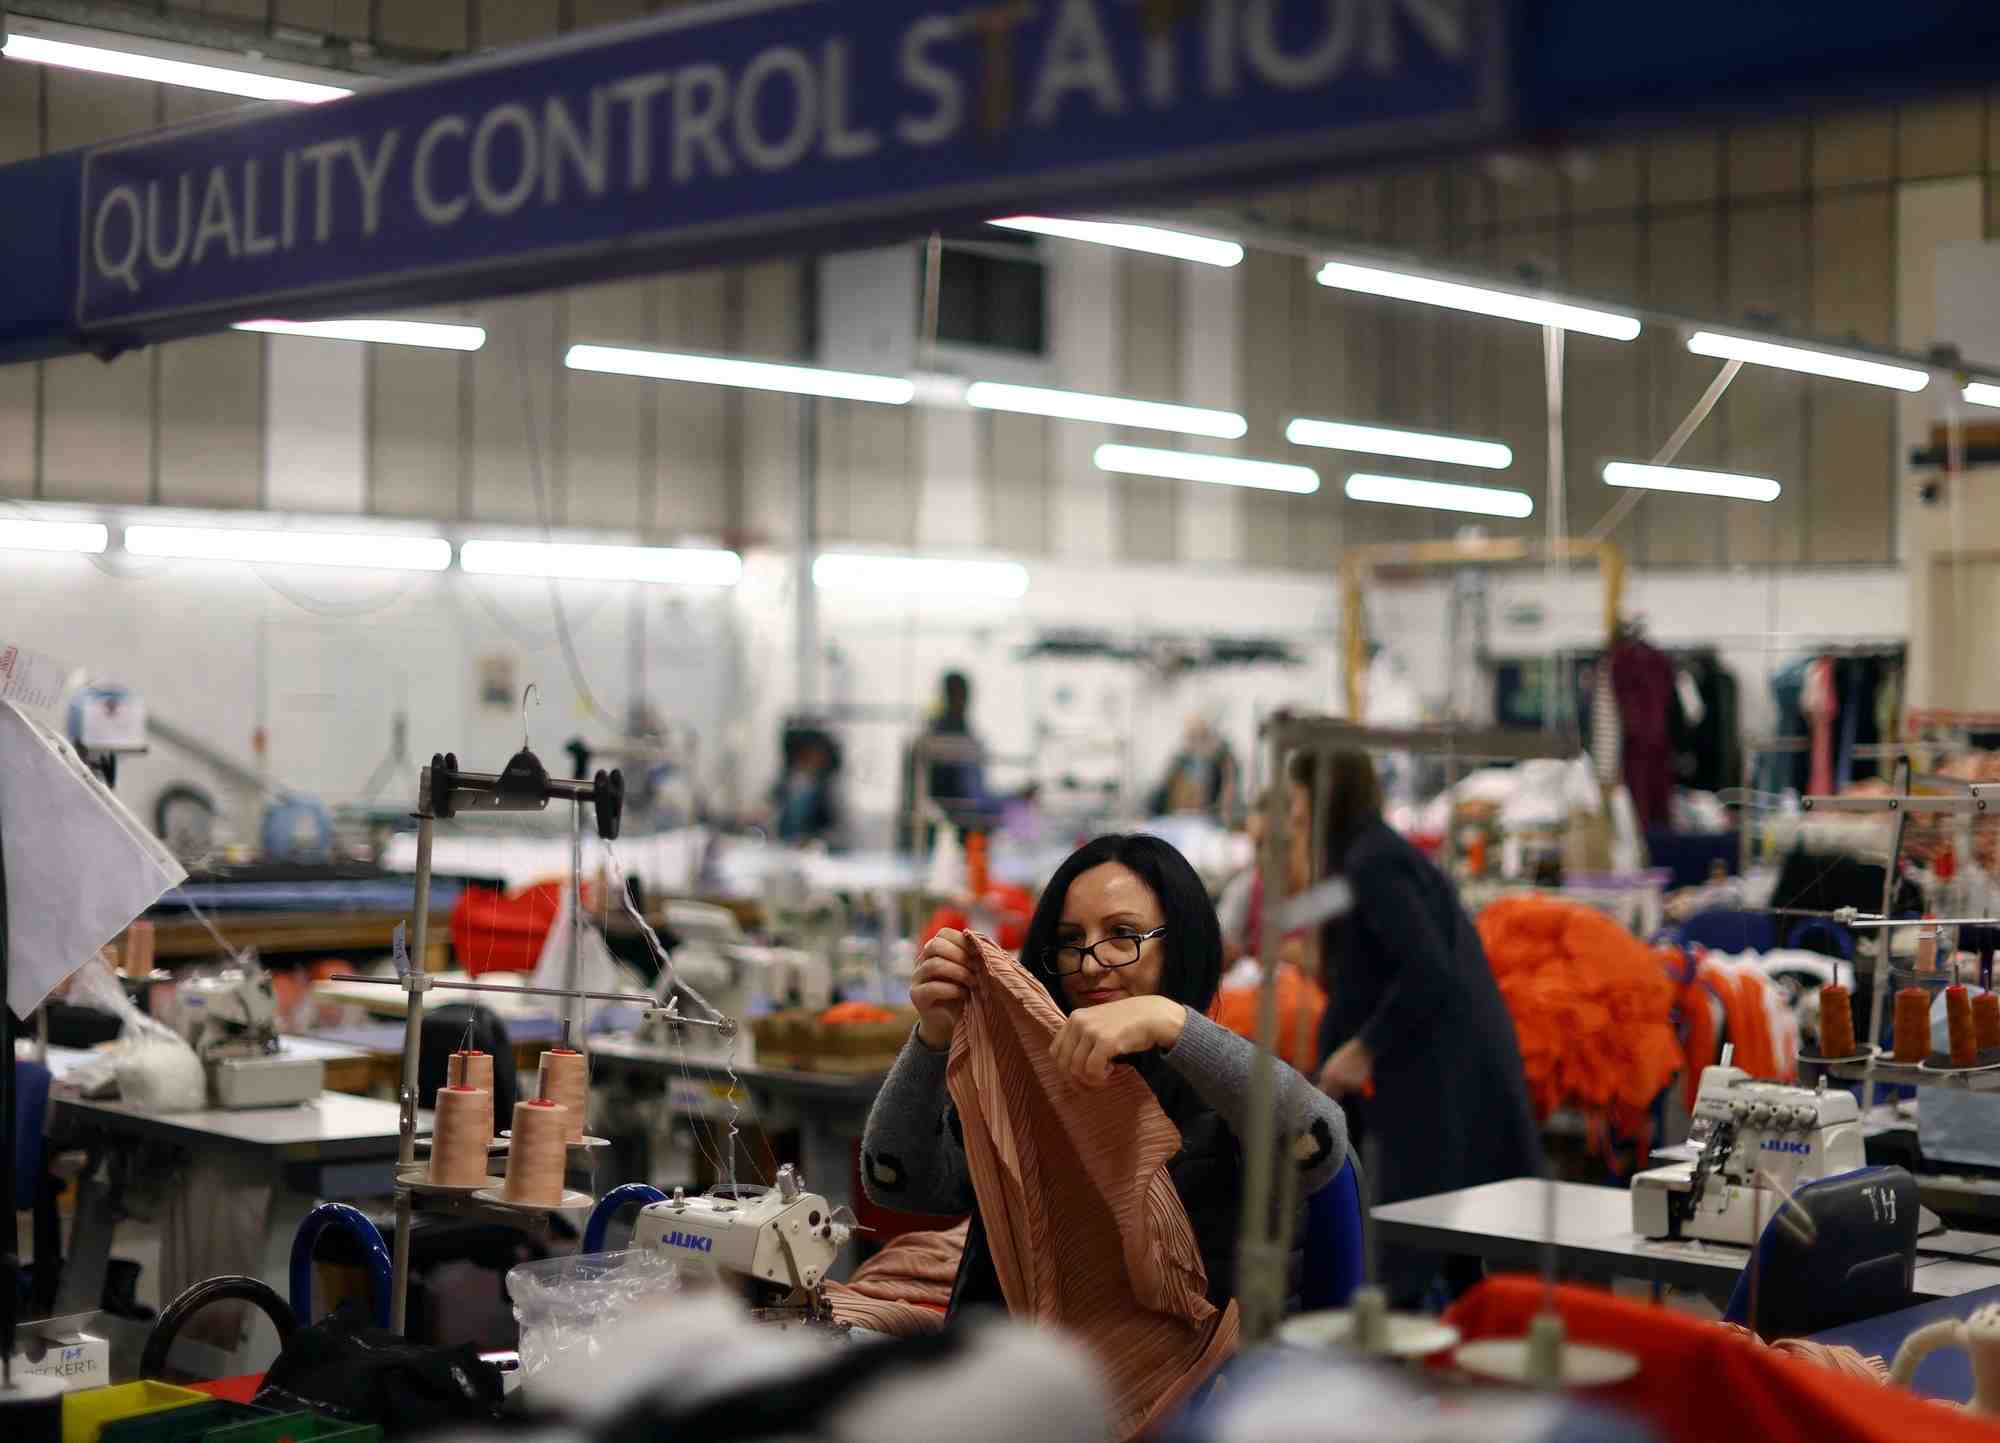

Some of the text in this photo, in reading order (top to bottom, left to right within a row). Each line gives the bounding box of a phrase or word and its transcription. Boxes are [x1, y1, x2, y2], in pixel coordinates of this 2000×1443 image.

[93, 129, 399, 290] QUALITY
[412, 37, 878, 226] CONTROL
[1760, 1139, 1810, 1154] JUKI
[662, 1231, 712, 1252] JUKI
